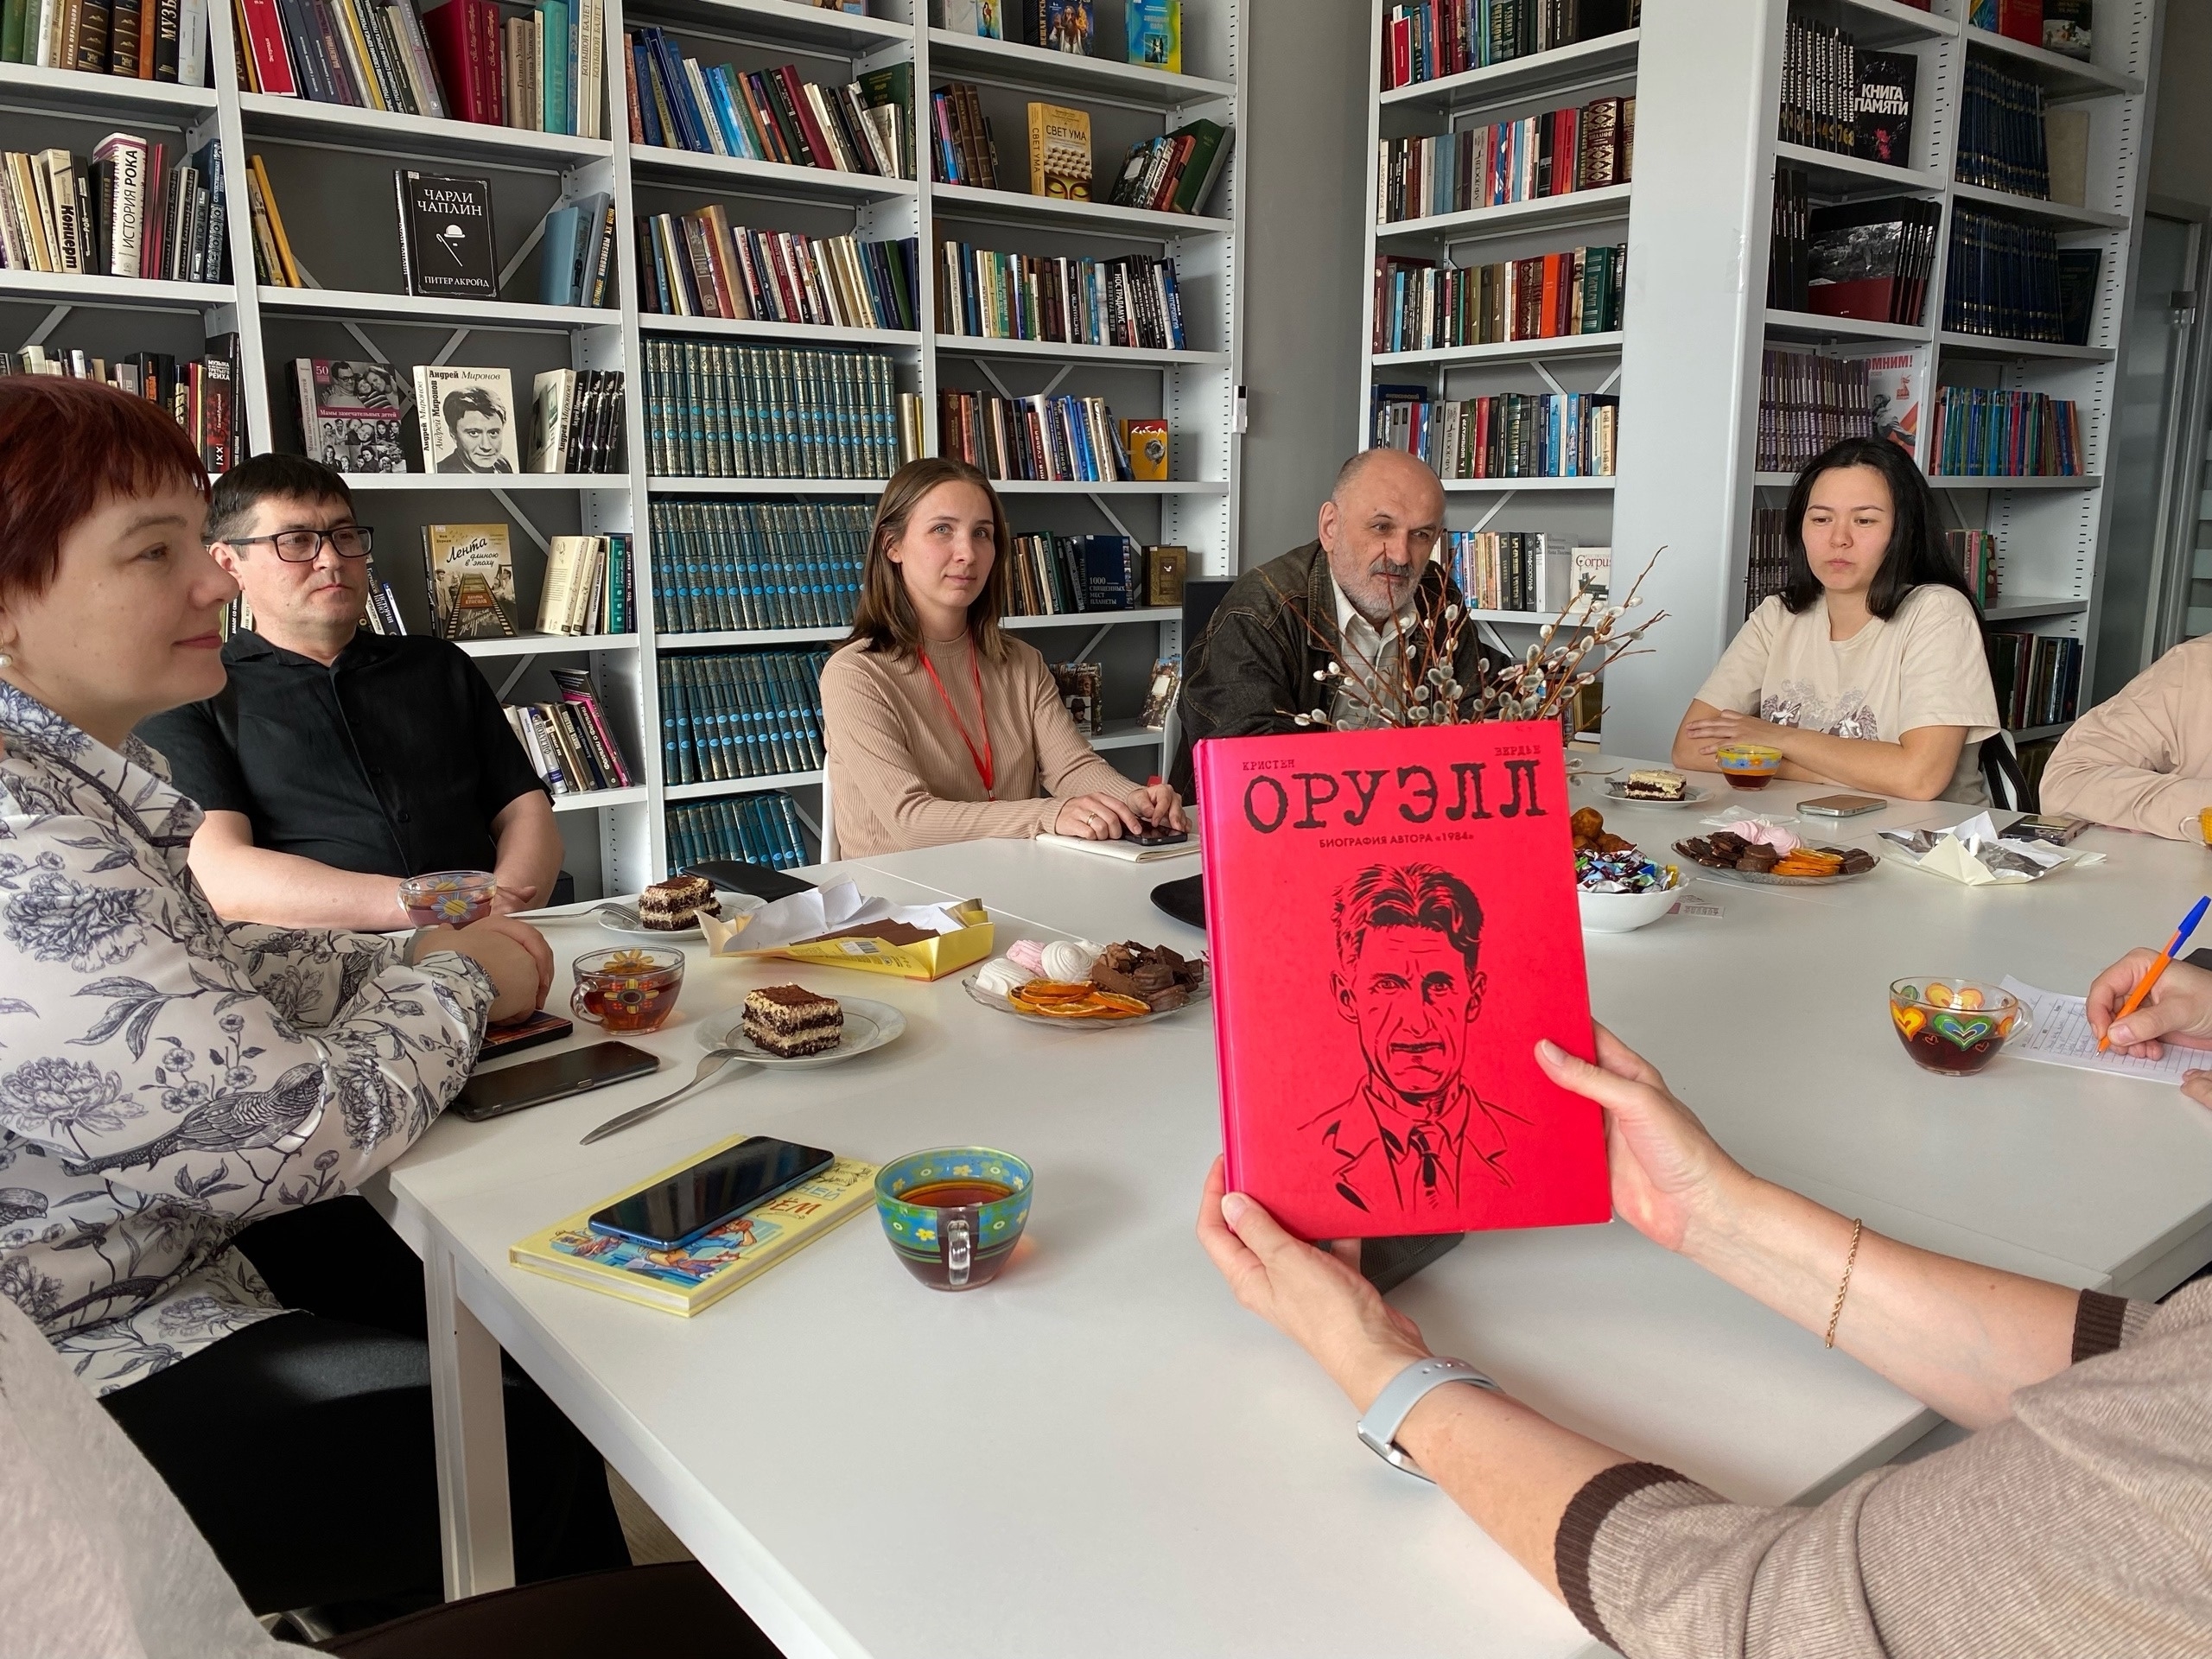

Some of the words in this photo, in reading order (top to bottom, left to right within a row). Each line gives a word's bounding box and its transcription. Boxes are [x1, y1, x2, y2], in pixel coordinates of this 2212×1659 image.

[69, 4, 78, 42] ОБРАЗЦОВА
[1491, 4, 1502, 41] МОНТЕНЬ
[1861, 84, 1904, 100] КНИГА
[1854, 98, 1908, 116] ПАМЯТИ
[1032, 128, 1040, 152] СВЕТ
[1046, 125, 1067, 137] СВЕТ
[1070, 130, 1087, 141] УМА
[124, 149, 137, 187] РОКА
[417, 200, 482, 216] ЧАПЛИН
[424, 189, 474, 204] ЧАРЛИ
[123, 189, 136, 249] ИСТОРИЯ
[61, 205, 77, 269] Концерт
[195, 224, 205, 251] ВИКТОР
[424, 276, 453, 285] ПИТЕР
[454, 277, 490, 288] АКРОЙД
[592, 278, 604, 306] ВЕЛИКИЕ
[598, 237, 611, 276] КИНОЗВЕЗДЫ
[1115, 273, 1126, 324] НОСТРАДАМУС
[1587, 276, 1599, 308] ПЛУТАРХ
[208, 372, 230, 381] РЕЙХА
[315, 365, 328, 375] 50
[429, 370, 459, 379] Андрей
[461, 372, 500, 381] Миронов
[416, 381, 427, 420] Миронов
[431, 380, 441, 417] Миронов
[562, 385, 572, 423] Миронов
[421, 423, 429, 451] Андрей
[435, 419, 443, 450] Андрей
[558, 424, 568, 453] Андрей
[447, 538, 488, 563] Лента
[470, 552, 499, 561] длиною
[1090, 576, 1106, 585] 1000
[536, 723, 551, 755] ФИЛАТОВ
[1243, 759, 1295, 772] КРИСТЕН
[1243, 760, 1549, 834] ОРУЭЛЛ
[1319, 836, 1388, 849] БИОГРАФИЯ
[1390, 834, 1433, 845] АВТОРА
[1435, 831, 1474, 842] «1984»
